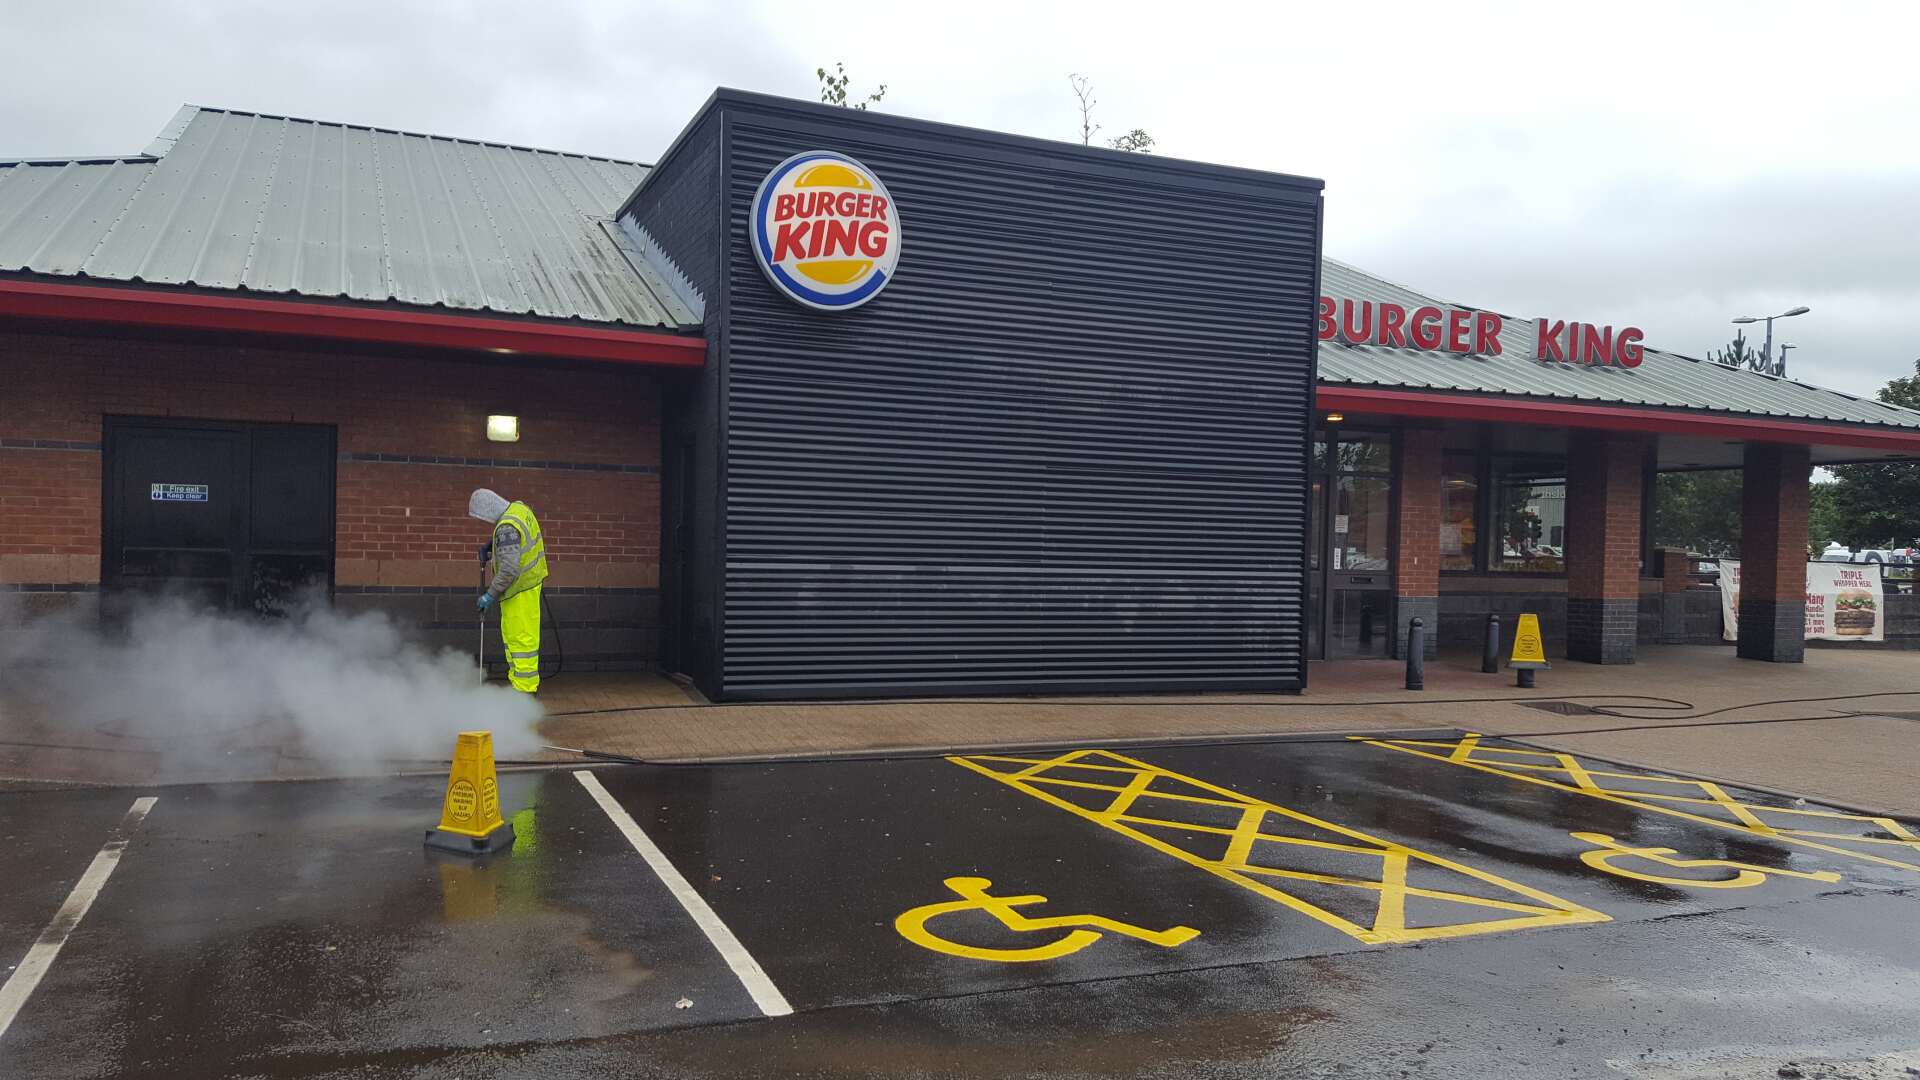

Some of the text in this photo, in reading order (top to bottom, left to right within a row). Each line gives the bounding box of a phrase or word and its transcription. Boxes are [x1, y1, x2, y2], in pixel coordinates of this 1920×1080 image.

[774, 191, 888, 222] BURGER
[773, 219, 889, 262] KING
[1317, 296, 1645, 369] BURGER KING
[1840, 570, 1863, 580] TRIPLE
[1858, 580, 1872, 588] MEAL
